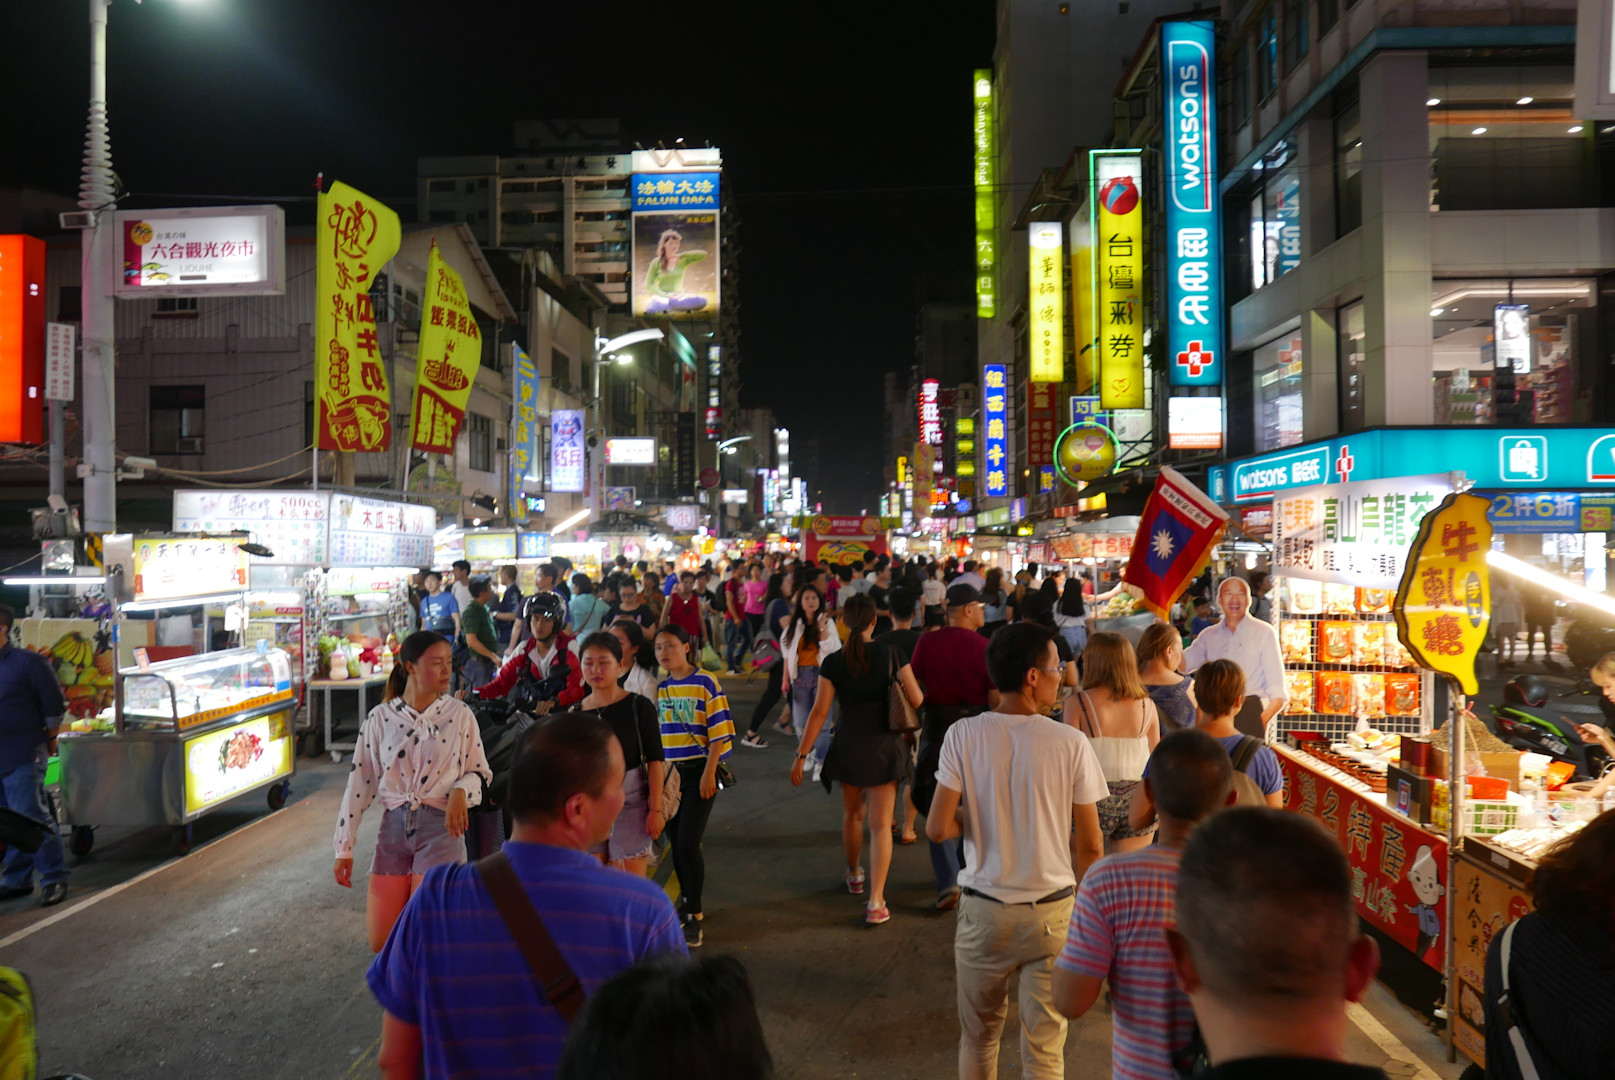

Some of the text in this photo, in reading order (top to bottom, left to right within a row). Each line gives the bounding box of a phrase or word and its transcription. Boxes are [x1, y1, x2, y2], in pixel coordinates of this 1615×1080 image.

[975, 102, 989, 185] Sunnyside Hotel
[1179, 65, 1200, 190] watsons
[637, 179, 715, 195] 法輪大法
[637, 195, 714, 206] FALUN DAFA
[151, 239, 254, 260] 六合觀光夜市
[1108, 232, 1139, 357] 台灣彩券
[1177, 228, 1209, 325] 屈臣氏
[986, 370, 1005, 491] 紐西蘭牛排
[1240, 458, 1320, 490] watsons 屈臣氏
[280, 507, 324, 520] 木瓜牛奶
[281, 497, 322, 508] 500cc
[1323, 490, 1434, 546] 高山烏龍茶
[1494, 494, 1576, 517] 2件6折
[1422, 521, 1480, 657] 牛軋糖
[1466, 581, 1482, 620] 手工
